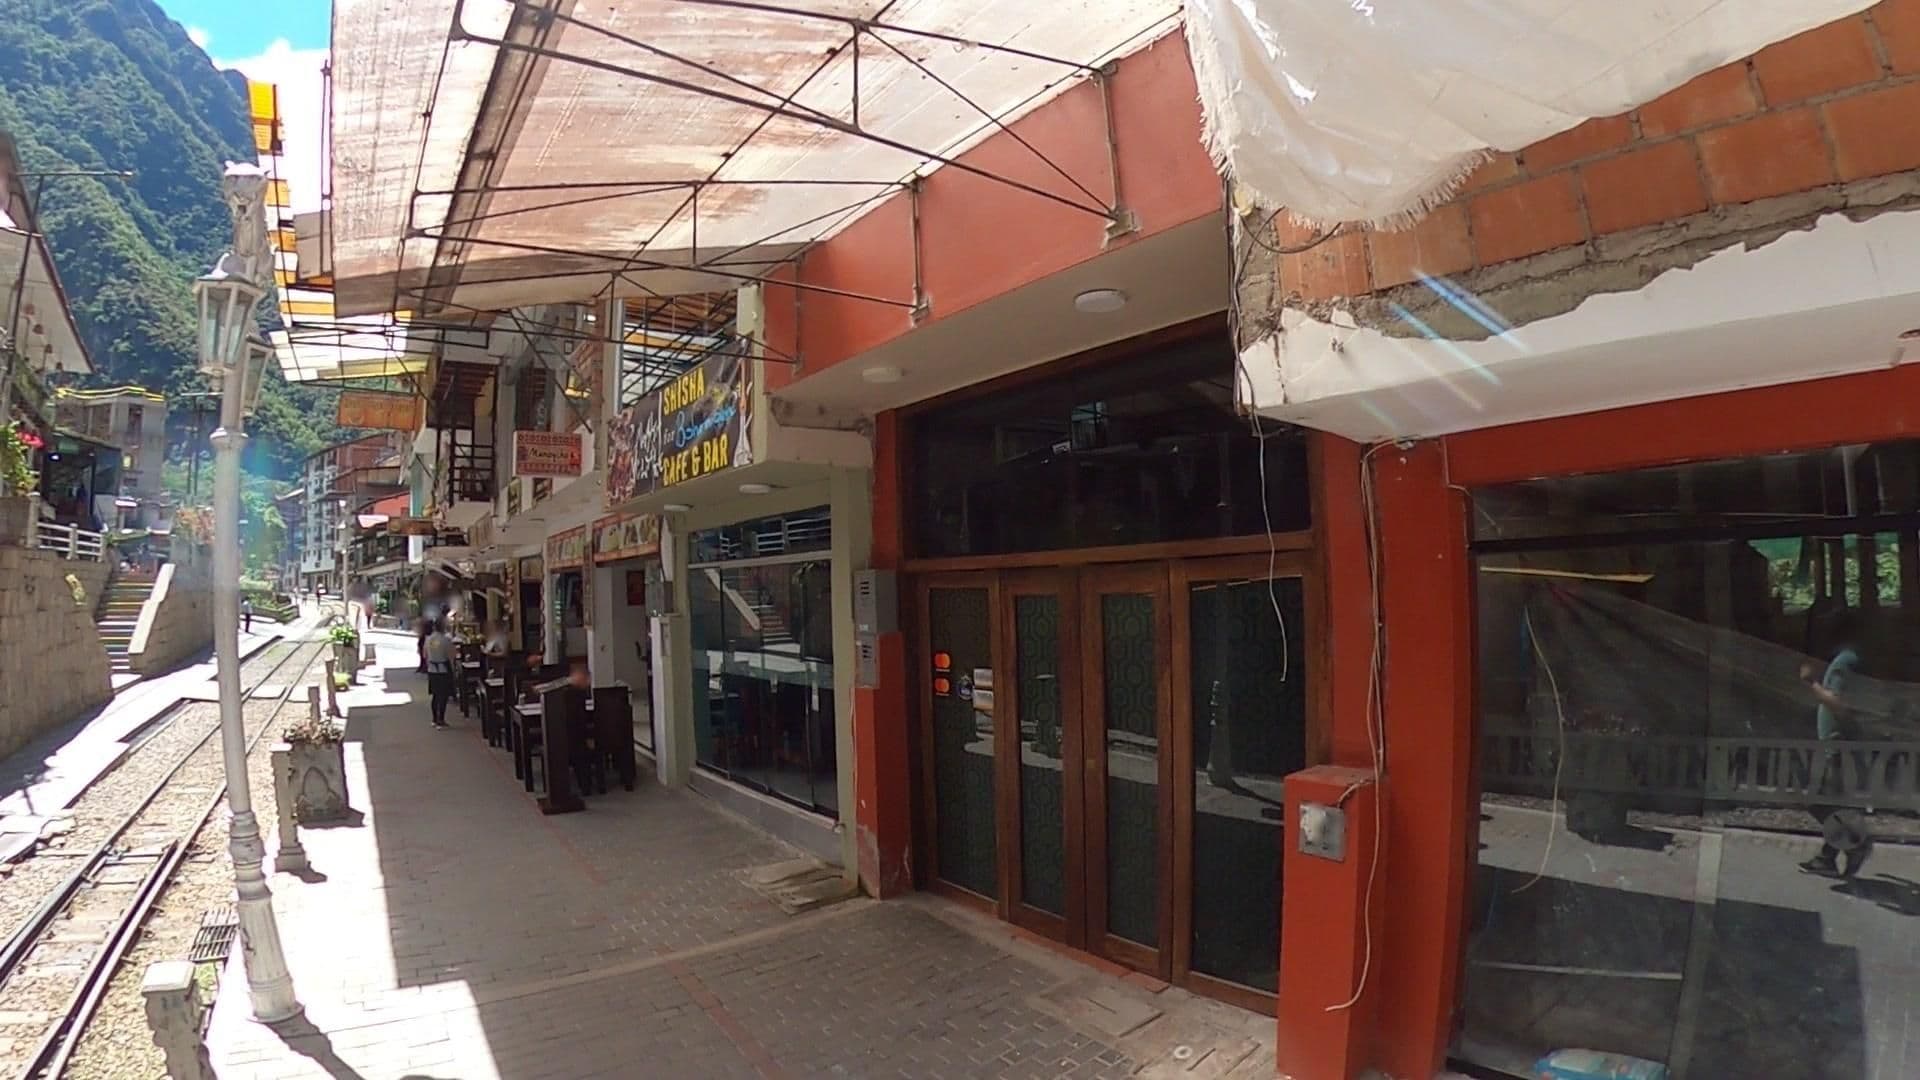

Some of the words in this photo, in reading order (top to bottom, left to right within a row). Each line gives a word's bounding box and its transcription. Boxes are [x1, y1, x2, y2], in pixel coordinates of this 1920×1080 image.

[664, 366, 705, 415] SHISHA
[663, 451, 687, 486] CAFE
[691, 447, 701, 475] &
[704, 434, 729, 471] BAR
